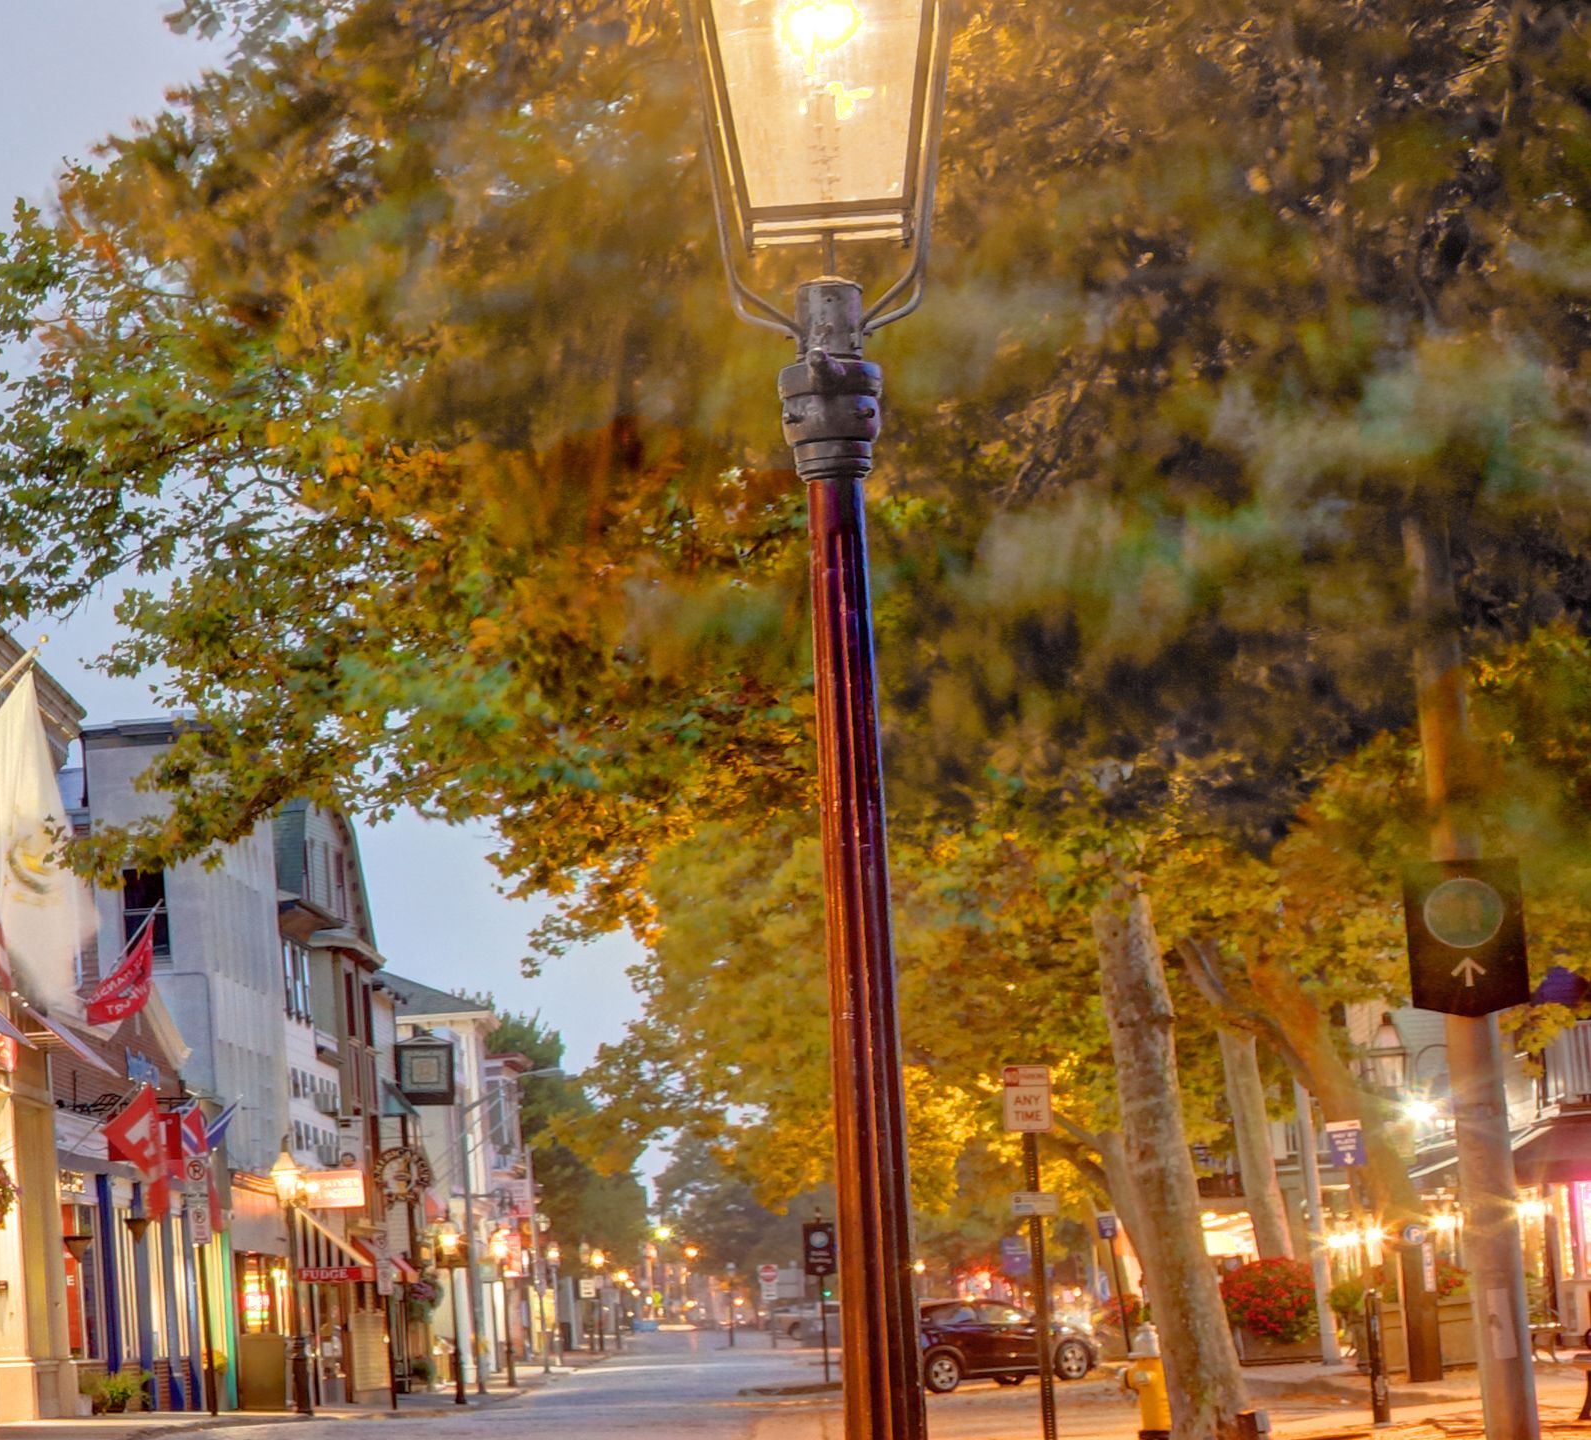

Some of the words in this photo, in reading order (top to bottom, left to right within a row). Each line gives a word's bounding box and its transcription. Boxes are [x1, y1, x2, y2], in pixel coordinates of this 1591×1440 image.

[1014, 1095, 1041, 1105] ANY
[1014, 1111, 1043, 1122] TIME
[301, 1268, 349, 1280] FUDGE
